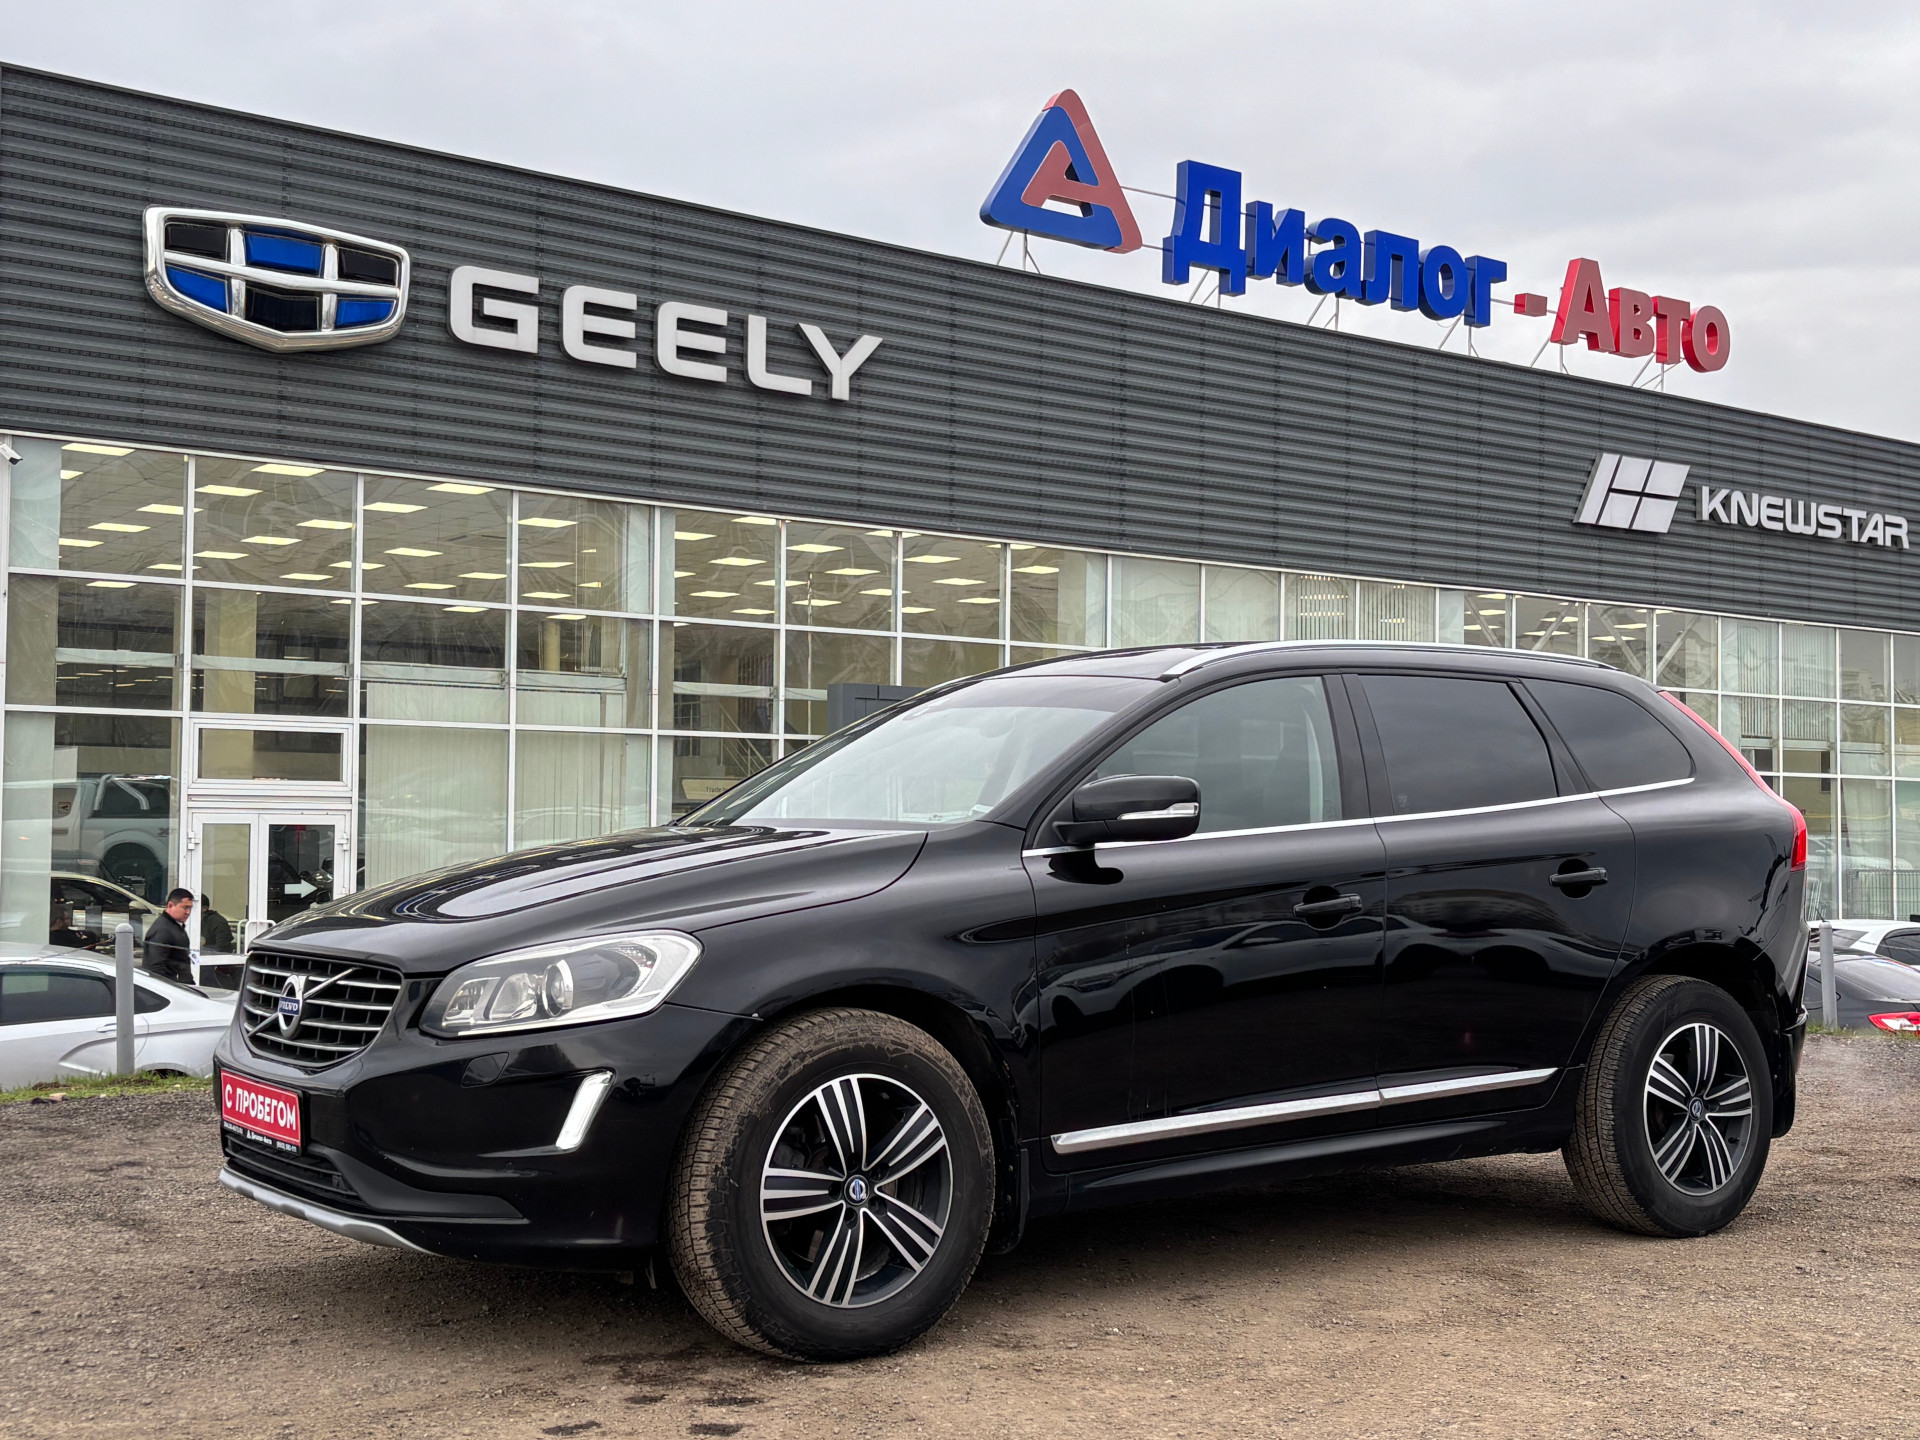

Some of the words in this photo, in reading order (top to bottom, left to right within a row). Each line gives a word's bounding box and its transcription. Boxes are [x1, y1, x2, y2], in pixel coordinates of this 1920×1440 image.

[447, 265, 884, 401] GEELY
[1697, 485, 1910, 549] KNEWSTAR
[225, 1083, 233, 1109] С
[235, 1087, 297, 1131] ПРОБЕГОМ
